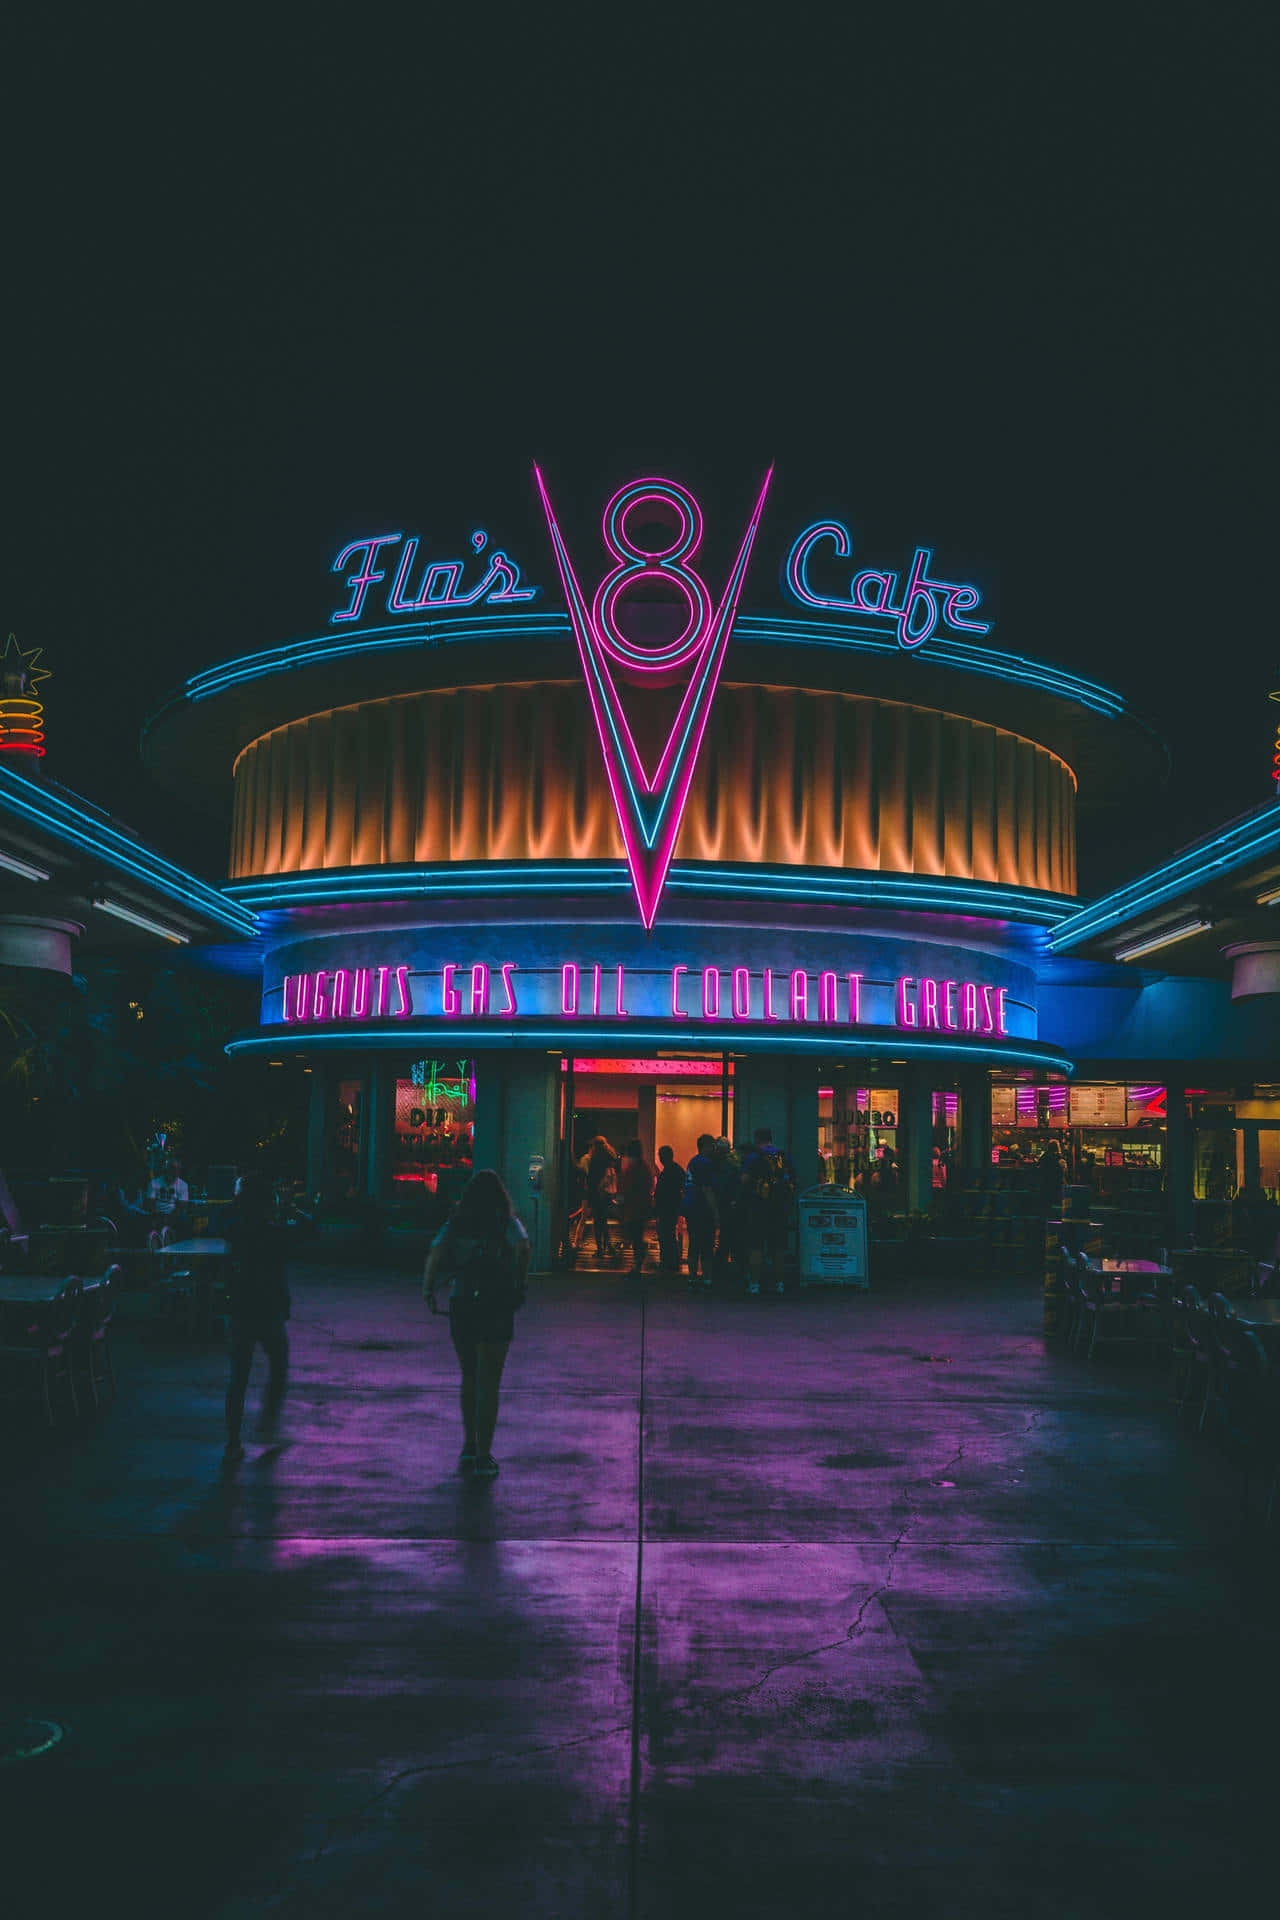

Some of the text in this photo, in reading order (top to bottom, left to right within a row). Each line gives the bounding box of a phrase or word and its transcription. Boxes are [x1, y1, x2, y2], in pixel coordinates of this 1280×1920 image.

[332, 531, 536, 623] Flo's
[786, 521, 989, 648] Cafe
[282, 963, 1009, 1034] LUGNUTS GAS OIL COOLANT GREASE
